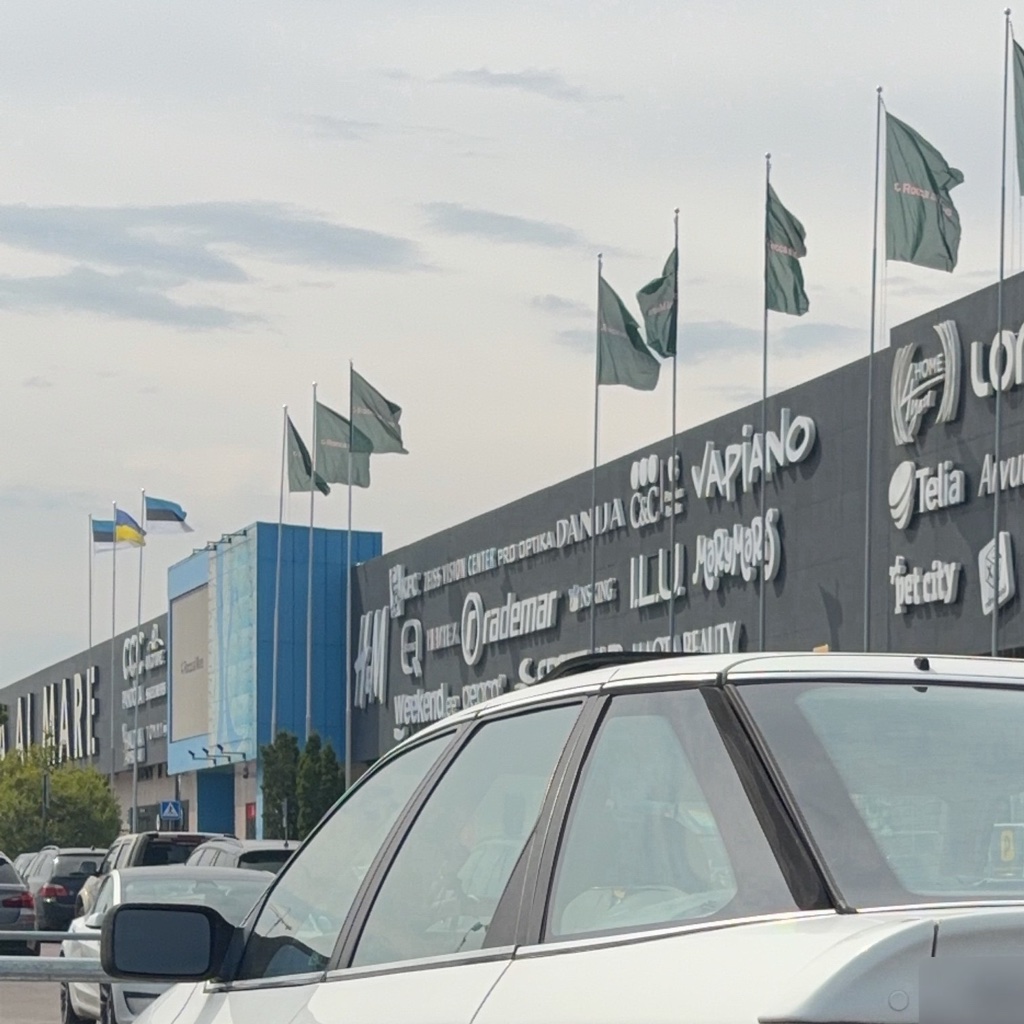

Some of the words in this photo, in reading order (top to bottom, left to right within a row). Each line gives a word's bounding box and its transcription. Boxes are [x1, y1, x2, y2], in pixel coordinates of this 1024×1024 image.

[916, 461, 965, 513] Telia
[483, 590, 561, 645] rademar
[42, 666, 96, 767] MARE
